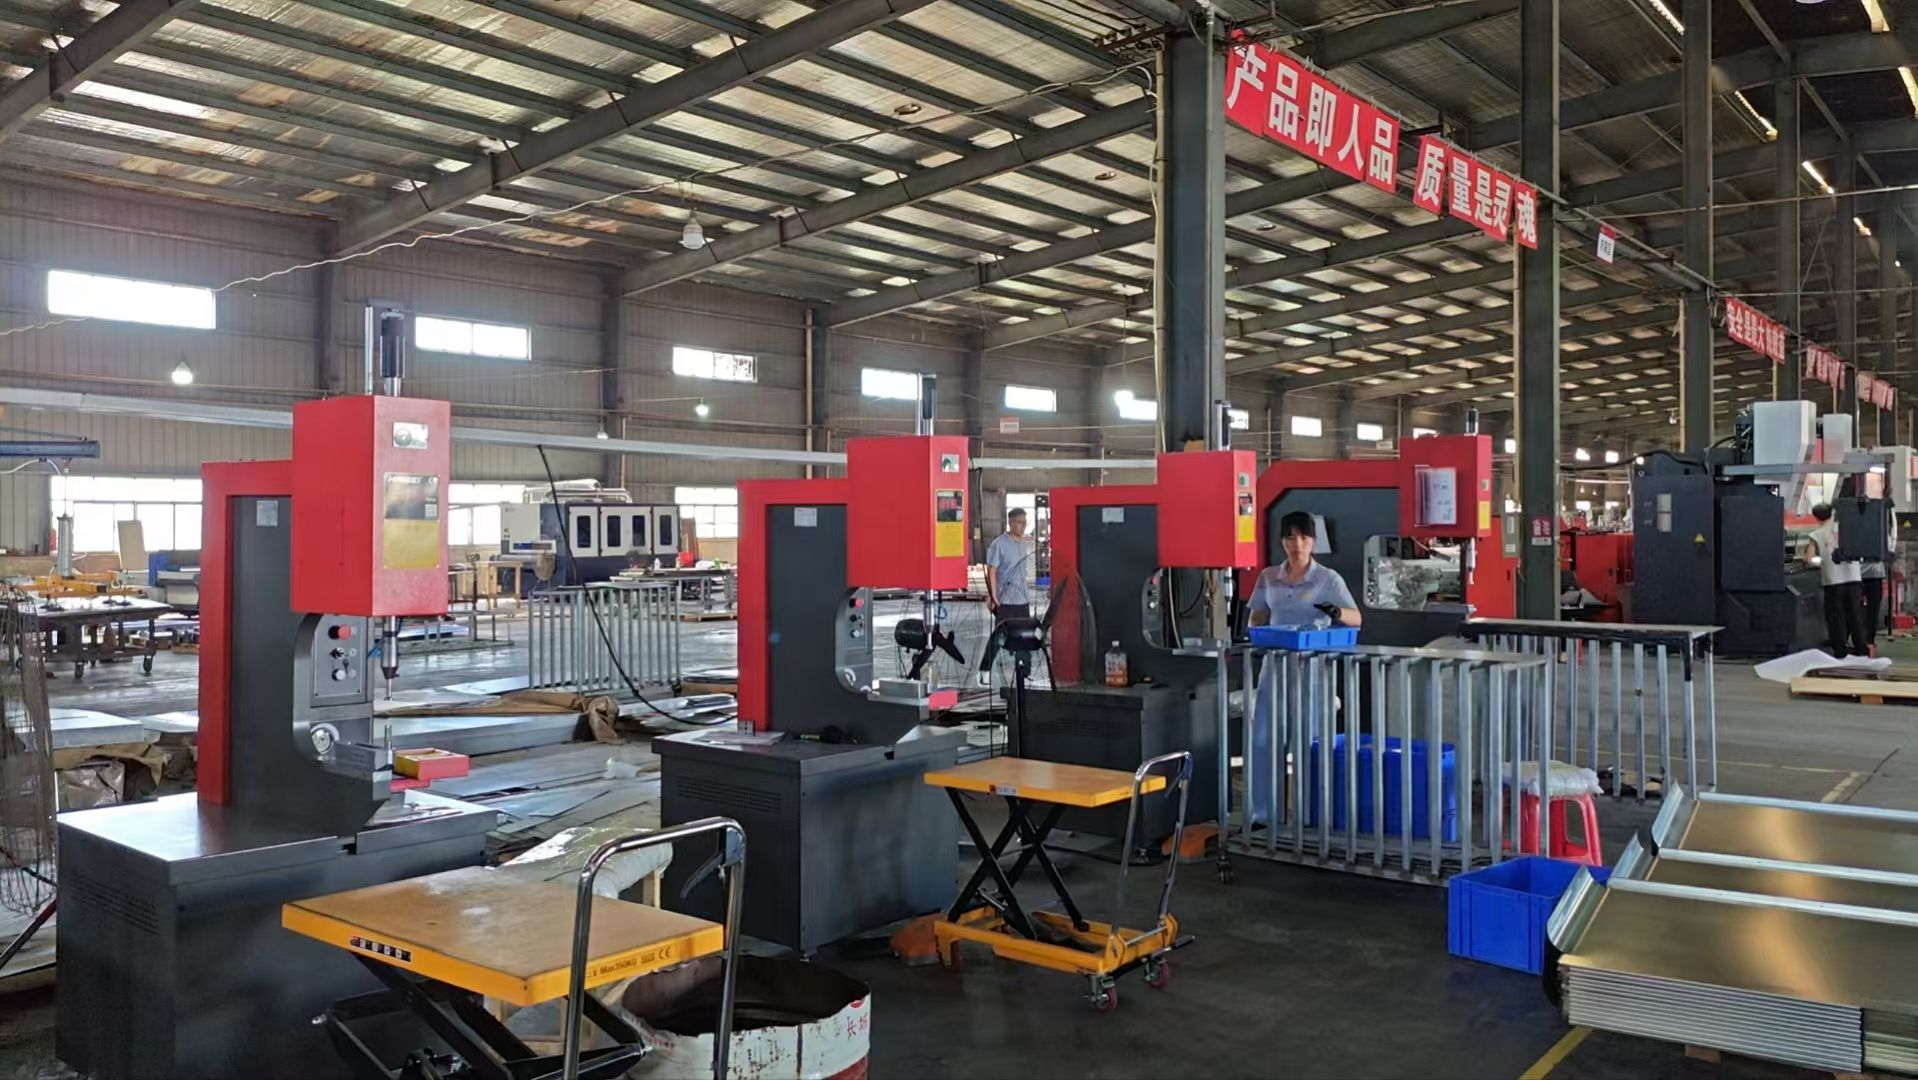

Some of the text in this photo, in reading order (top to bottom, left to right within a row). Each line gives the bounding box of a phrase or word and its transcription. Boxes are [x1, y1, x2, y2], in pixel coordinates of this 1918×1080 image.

[1226, 44, 1537, 243] 产品即人品 质量是灵魂
